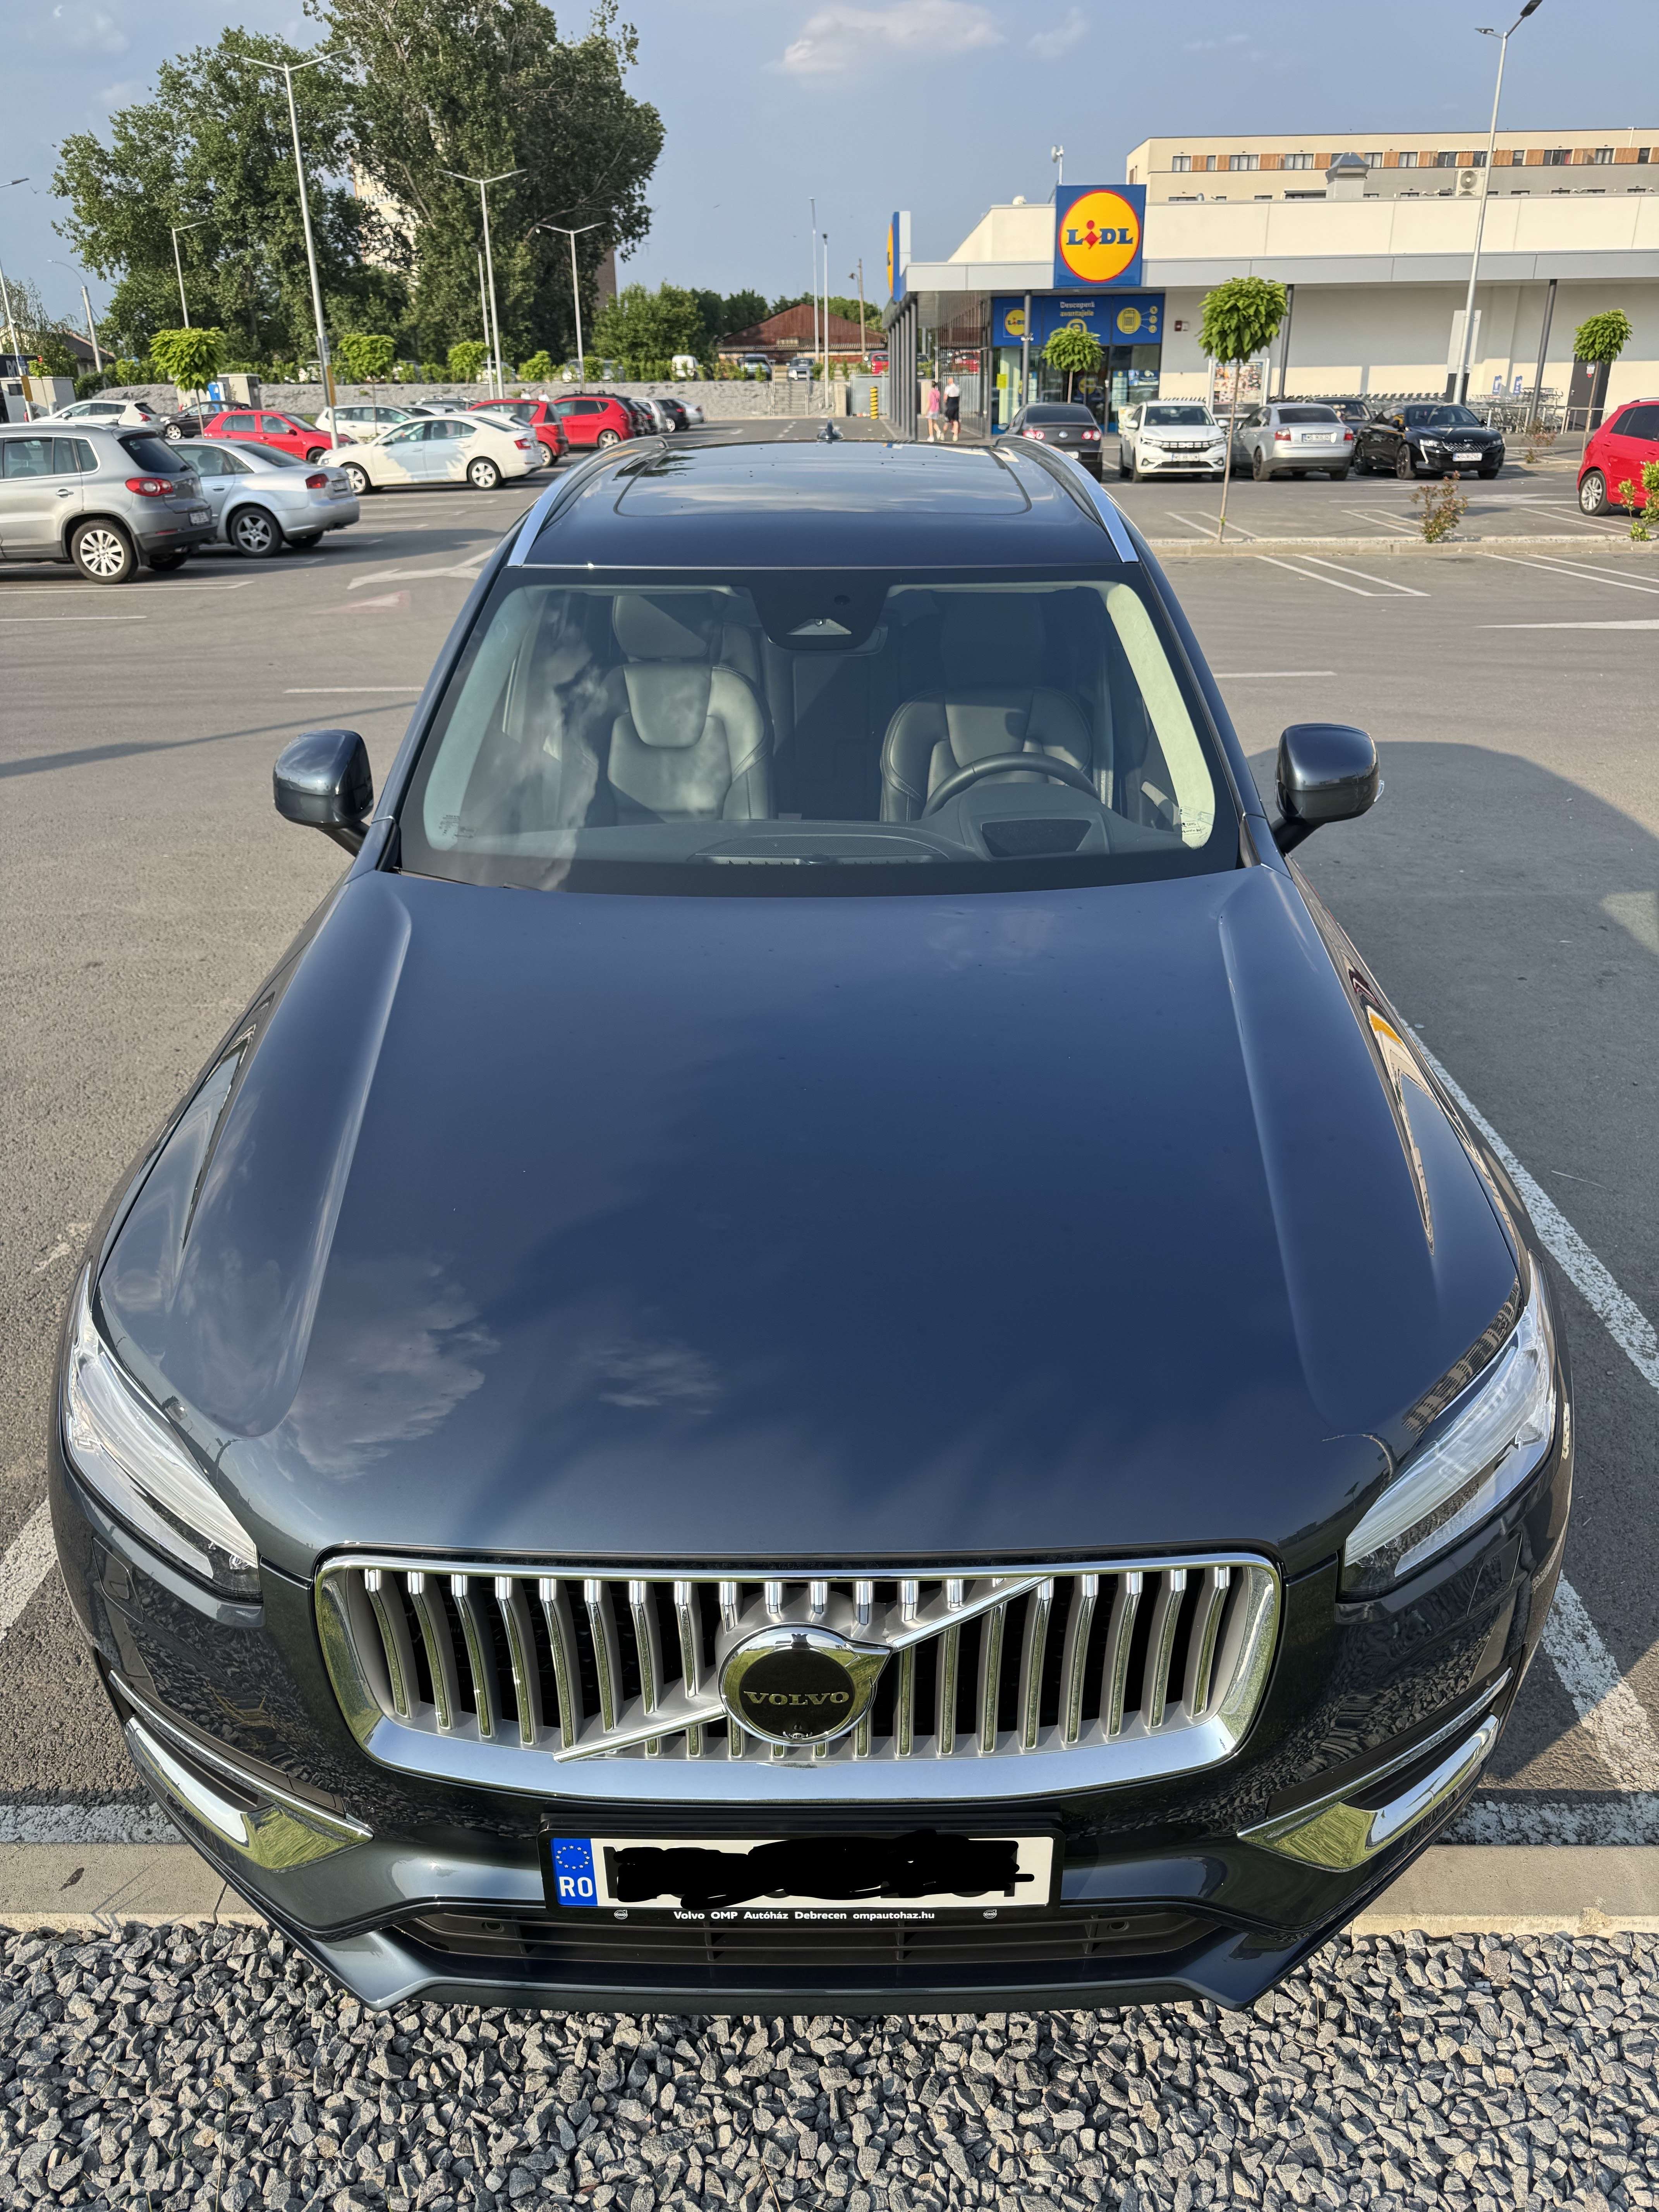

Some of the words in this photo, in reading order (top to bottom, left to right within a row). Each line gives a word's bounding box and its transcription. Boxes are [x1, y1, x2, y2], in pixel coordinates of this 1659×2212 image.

[744, 1691, 849, 1705] VOLVO
[559, 1876, 593, 1897] RO
[673, 1911, 705, 1919] Volvo
[743, 1911, 788, 1919] Autóház
[795, 1911, 847, 1919] Debrecen
[853, 1911, 935, 1921] ompautohaz.hu
